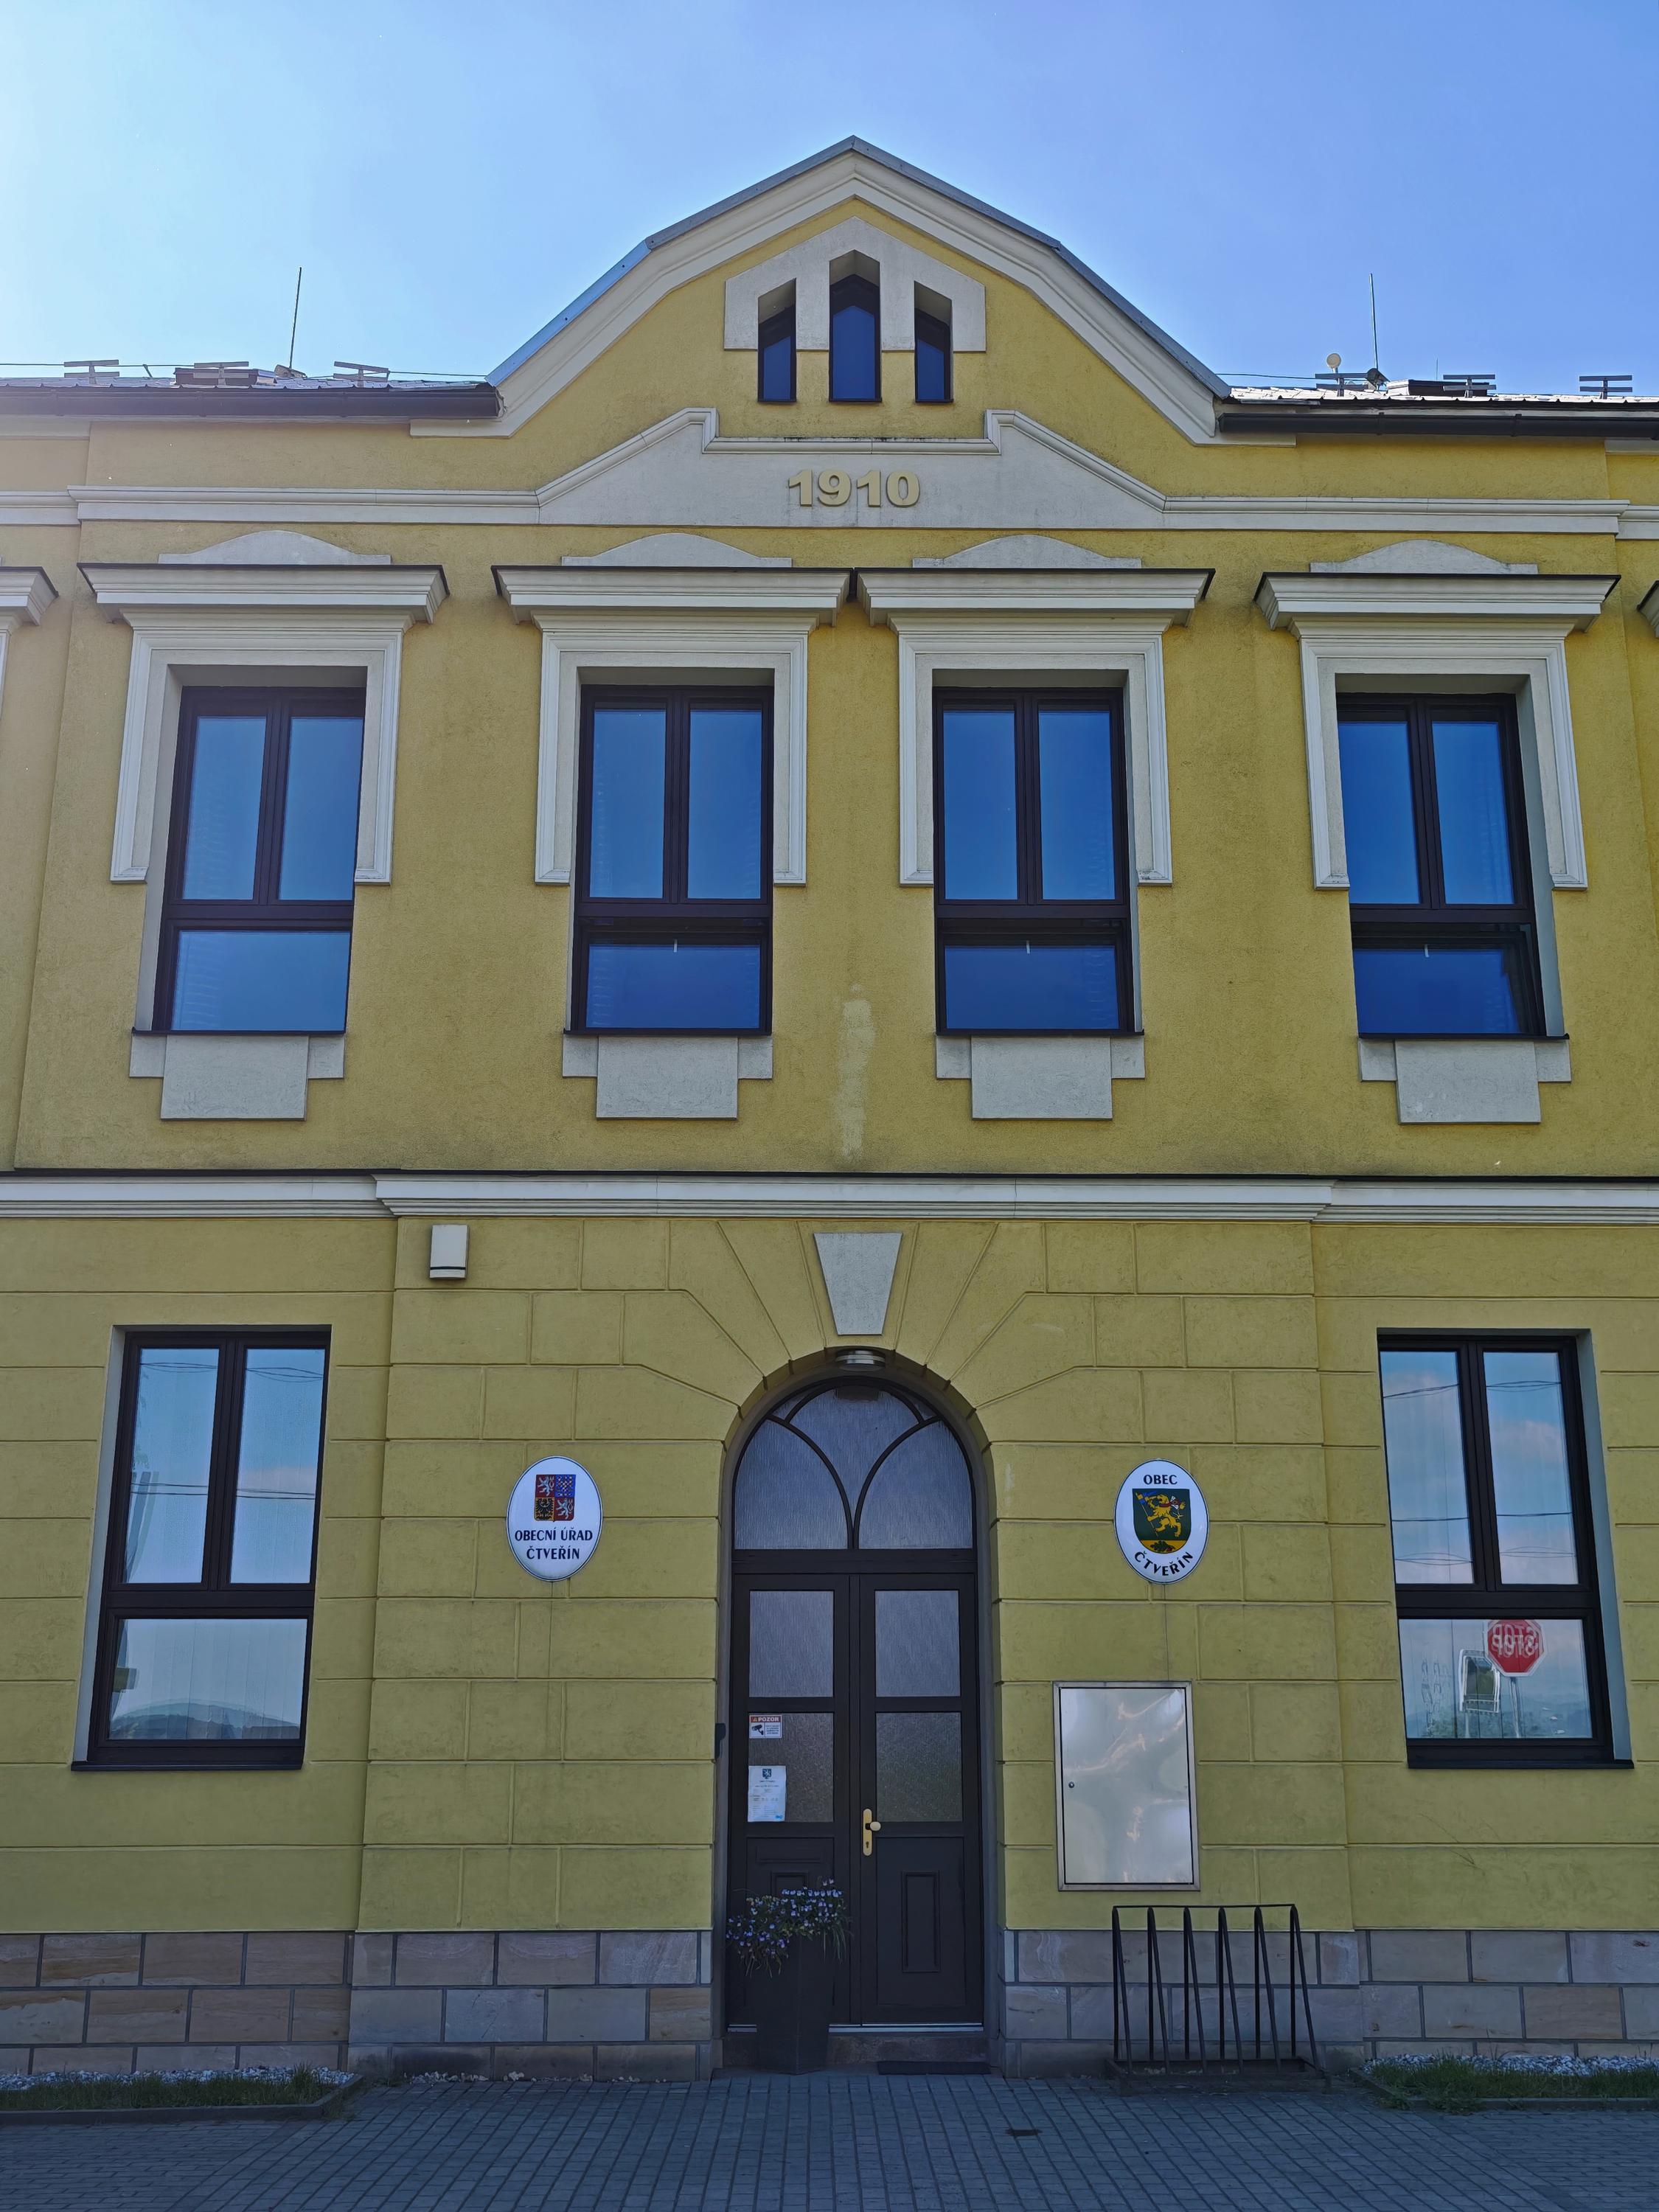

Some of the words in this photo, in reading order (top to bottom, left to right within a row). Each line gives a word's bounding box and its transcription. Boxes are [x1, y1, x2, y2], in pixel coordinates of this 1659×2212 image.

[787, 469, 920, 507] 1910
[1143, 1474, 1178, 1485] OBEC
[515, 1527, 557, 1541] OBECNÍ
[560, 1527, 593, 1541] ÚŘAD
[526, 1545, 580, 1559] ČTVEŘÍN
[1134, 1551, 1194, 1576] ČTVEŘÍN
